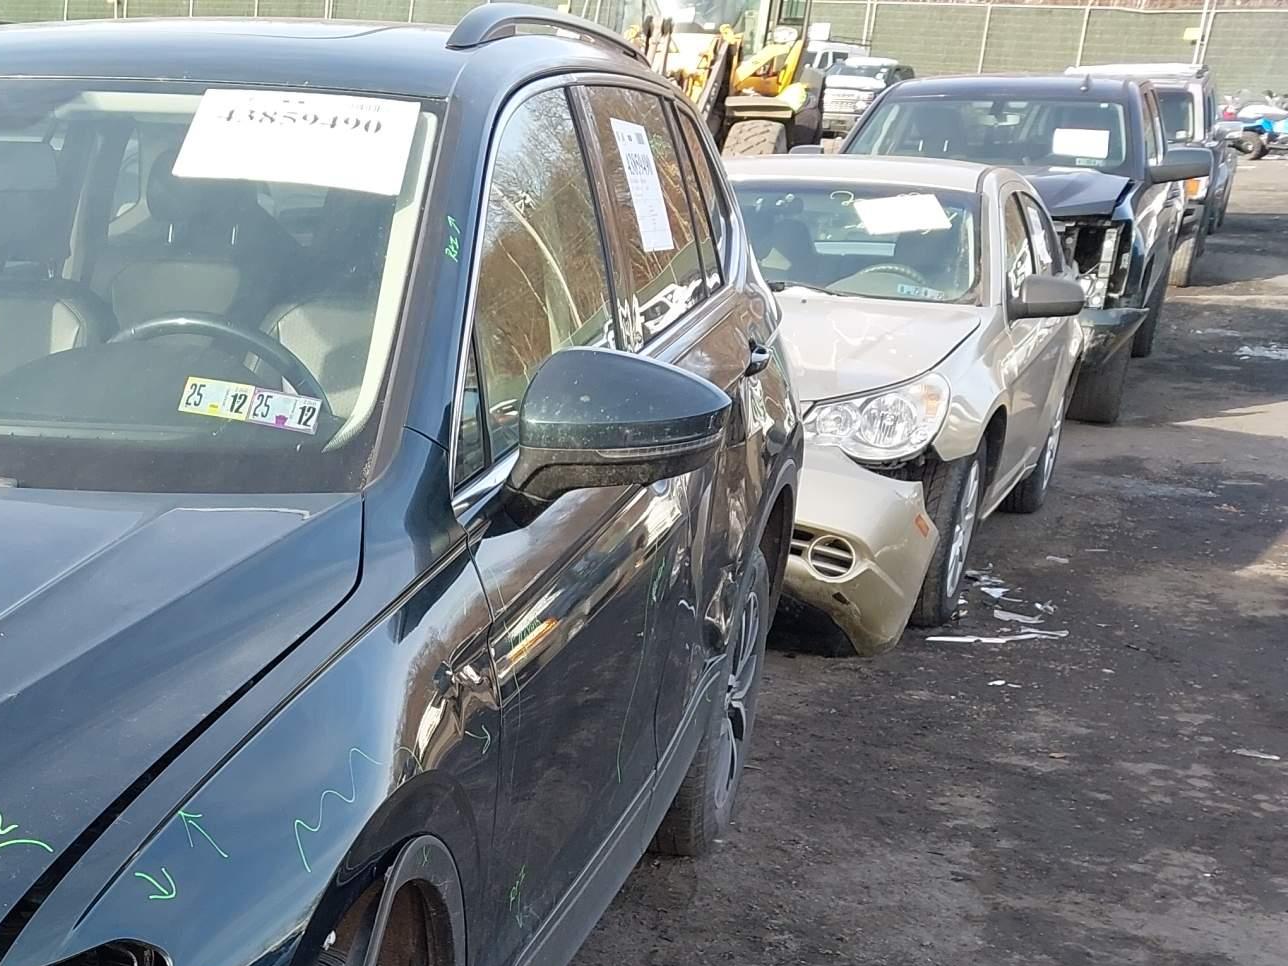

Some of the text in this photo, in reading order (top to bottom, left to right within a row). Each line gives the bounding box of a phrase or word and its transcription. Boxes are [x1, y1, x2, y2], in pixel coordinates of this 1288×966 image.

[185, 383, 248, 414] 25 12
[252, 394, 317, 427] 25 12
